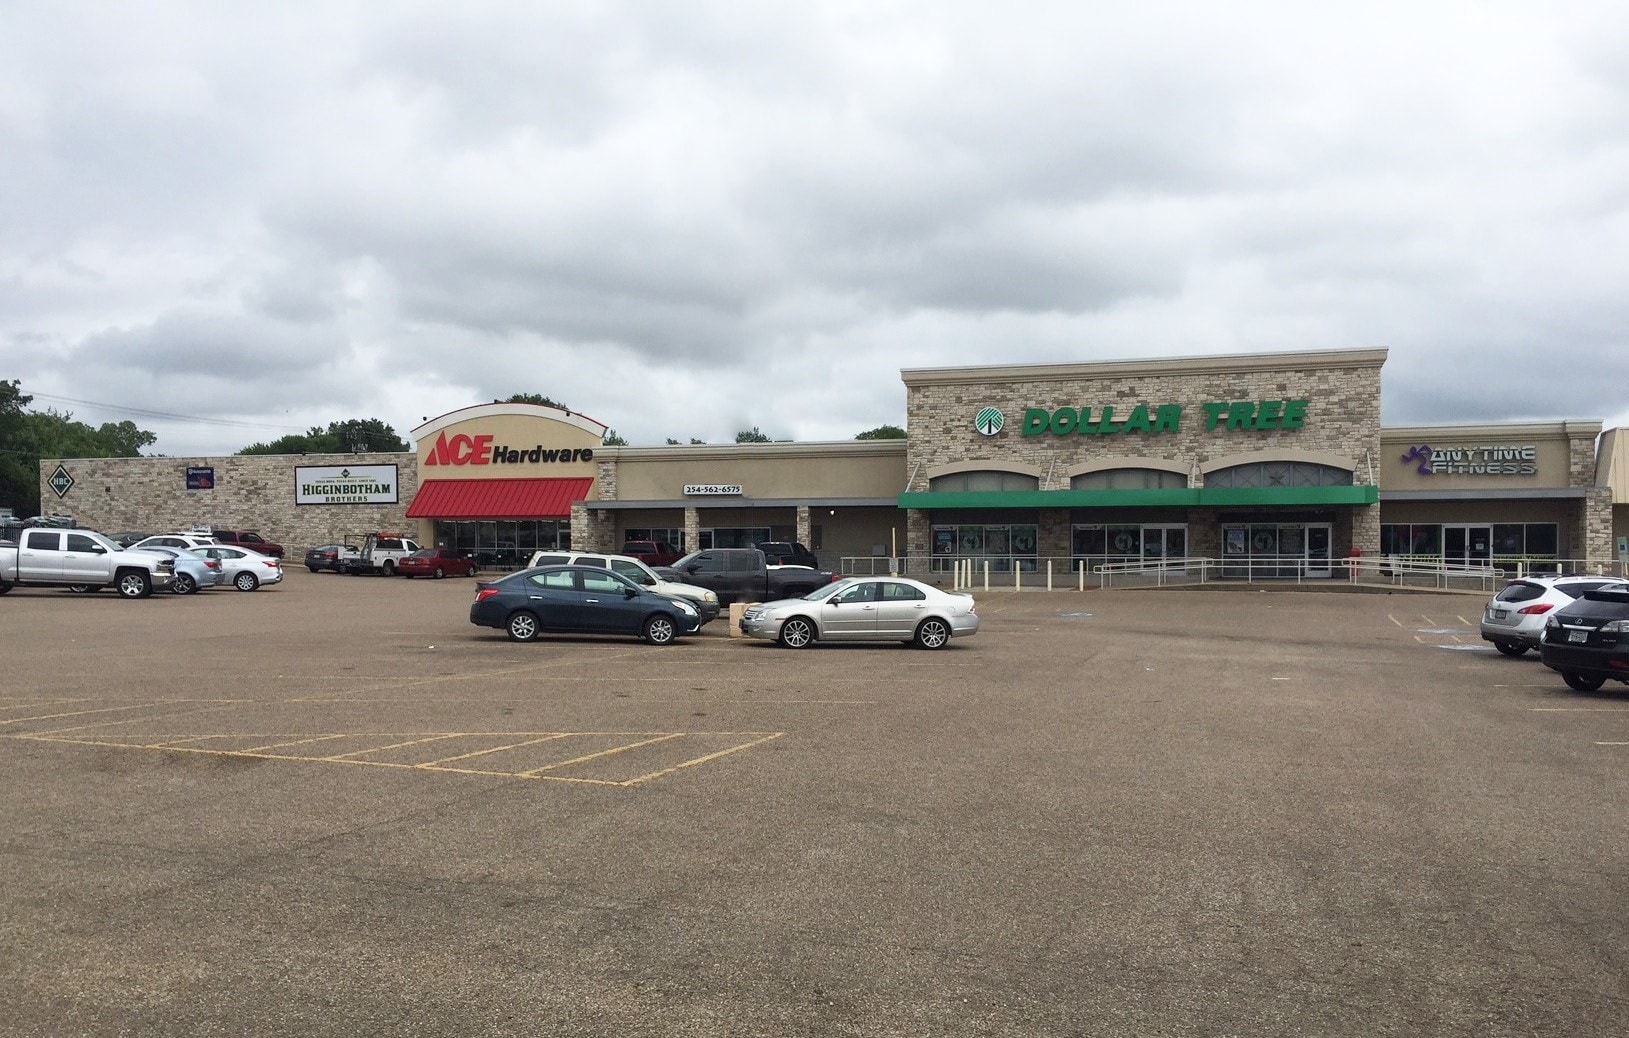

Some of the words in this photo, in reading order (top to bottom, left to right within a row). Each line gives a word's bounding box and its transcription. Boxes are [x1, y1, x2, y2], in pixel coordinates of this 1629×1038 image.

[1021, 405, 1183, 436] DOLLAR
[1203, 399, 1309, 431] TREE
[424, 430, 494, 466] ACE
[492, 445, 593, 464] Hardware
[1430, 445, 1536, 461] ANYTIME
[1432, 461, 1536, 474] FITNESS
[53, 477, 68, 485] HBC
[302, 484, 391, 496] HIGGINBOTHAM
